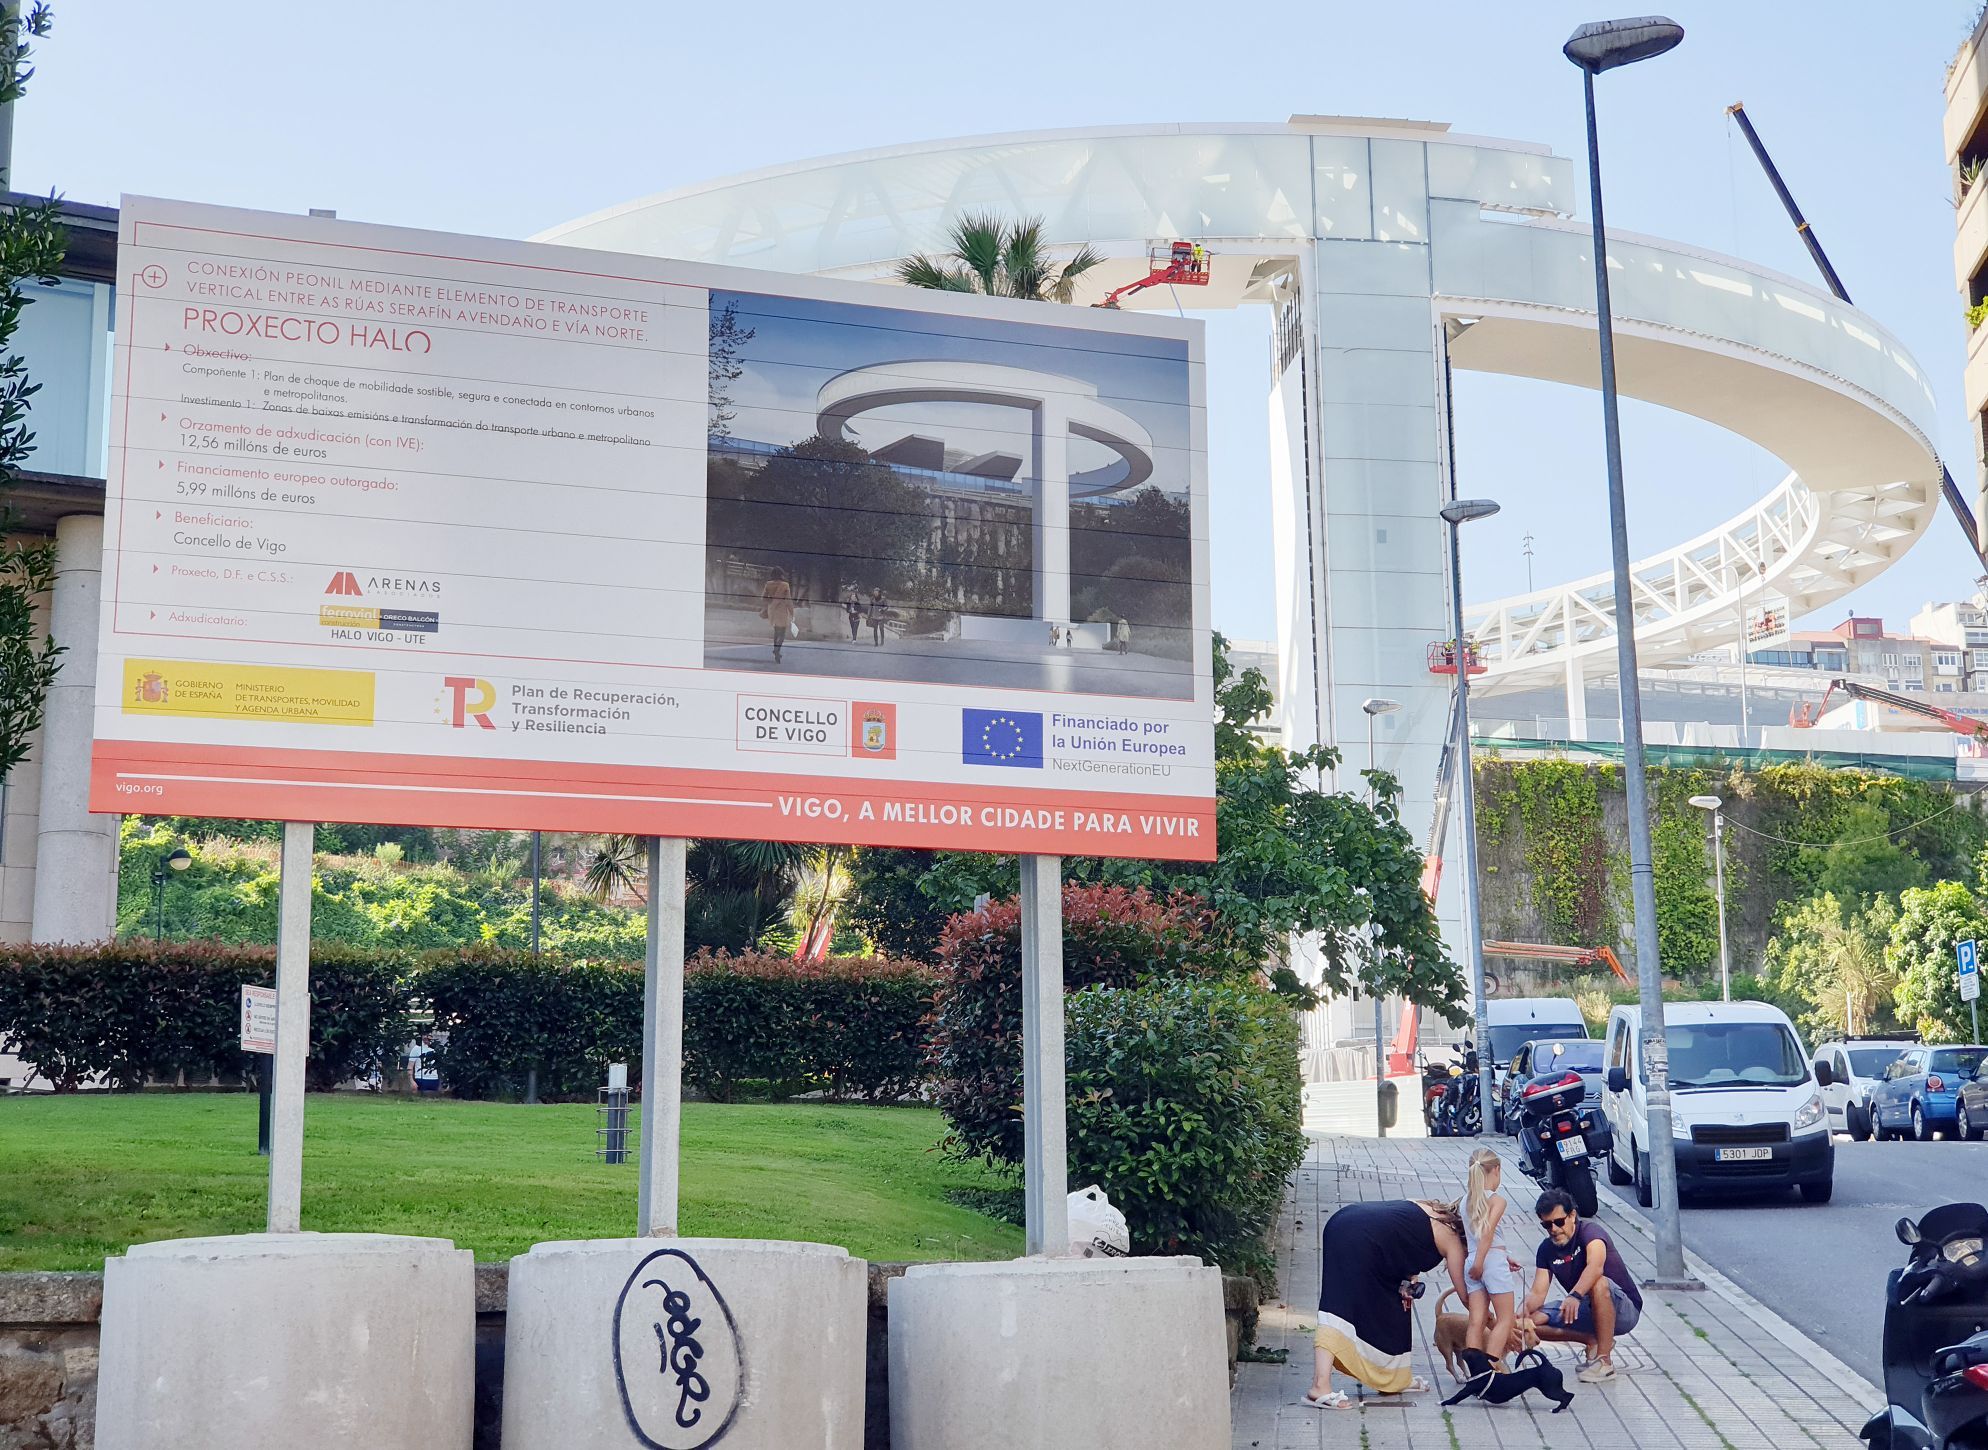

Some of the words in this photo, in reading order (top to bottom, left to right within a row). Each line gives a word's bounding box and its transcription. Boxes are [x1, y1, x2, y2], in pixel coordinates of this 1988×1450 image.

[187, 261, 280, 282] CONEXIÓN
[286, 272, 344, 290] PEONIL
[350, 279, 432, 299] MEDIANTE
[437, 288, 520, 308] ELEMENTO
[525, 298, 545, 311] DE
[550, 300, 648, 323] TRANSPORTE
[187, 281, 263, 301] VERTICAL
[268, 290, 315, 306] ENTRE
[320, 296, 339, 309] AS
[345, 296, 384, 314] RÚAS
[389, 303, 451, 320] SERAFÍN
[457, 310, 547, 330] AVENDAÑO
[552, 320, 560, 332] E
[565, 319, 590, 335] VÍA
[595, 325, 648, 342] NORTE.
[184, 307, 340, 345] PROXECTO
[350, 324, 431, 353] HALO
[183, 344, 252, 362] Obxectivo:
[182, 362, 247, 380] Compoñente
[264, 370, 285, 383] Plan
[288, 373, 301, 384] de
[303, 374, 340, 389] choque
[343, 378, 356, 389] de
[359, 380, 414, 395] mobilidade
[416, 386, 454, 400] sostible,
[458, 391, 491, 403] segura
[493, 394, 500, 403] e
[502, 394, 552, 408] conectada
[555, 400, 567, 409] en
[569, 402, 615, 415] contornos
[617, 406, 655, 418] urbanos
[263, 388, 270, 396] e
[273, 387, 348, 405] metropolitanos.
[180, 393, 242, 409] Investimento
[263, 401, 293, 413] Zonas
[296, 404, 309, 414] de
[312, 406, 344, 418] baixas
[347, 408, 389, 422] emisións
[392, 415, 399, 423] e
[401, 414, 473, 430] transformación
[475, 420, 489, 431] do
[491, 422, 539, 438] transporte
[542, 427, 576, 440] urbano
[578, 432, 584, 440] e
[587, 431, 651, 447] metropolitano
[179, 417, 251, 435] Orzamento
[256, 423, 272, 437] de
[276, 427, 360, 445] adxudicación
[365, 433, 391, 449] (con
[396, 436, 424, 452] IVE):
[180, 433, 219, 450] 12,56
[224, 438, 268, 454] millóns
[273, 443, 289, 456] de
[293, 447, 327, 459] euros
[177, 460, 270, 480] Financiamento
[273, 472, 326, 486] europeo
[330, 475, 399, 492] outorgado:
[176, 481, 207, 497] 5,99
[211, 485, 256, 501] millóns
[261, 488, 277, 501] de
[281, 493, 316, 505] euros
[175, 511, 253, 528] Beneficiario:
[173, 531, 231, 548] Concello
[235, 536, 252, 549] de
[257, 537, 287, 555] Vigo
[171, 565, 219, 579] Proxecto,
[367, 577, 441, 593] ARENAS
[168, 611, 248, 626] Adxudicatario:
[331, 629, 362, 640] HALO
[367, 631, 394, 643] VIGO
[404, 634, 426, 645] UTE
[174, 690, 187, 698] DE
[190, 689, 223, 700] ESPAÑA
[175, 680, 223, 690] GOBIERNO
[235, 683, 285, 693] MINISTERIO
[235, 694, 247, 702] DE
[248, 694, 311, 706] TRANSPORTES,
[311, 698, 361, 708] MOVILIDAD
[511, 684, 544, 699] Plan
[549, 687, 568, 700] de
[573, 688, 680, 708] Recuperación,
[235, 704, 240, 712] Y
[241, 704, 279, 714] AGENDA
[281, 706, 319, 716] URBANA
[511, 702, 631, 721] Transformación
[745, 707, 838, 726] CONCELLO
[511, 720, 520, 733] y
[525, 719, 607, 735] Resiliencia
[756, 725, 778, 740] DE
[785, 727, 827, 743] VIGO
[1052, 713, 1139, 732] Financiado
[1143, 722, 1170, 736] por
[1052, 734, 1065, 748] la
[1071, 735, 1117, 751] Unión
[1122, 738, 1186, 757] Europea
[1052, 757, 1171, 777] NextGenerationEU
[115, 781, 163, 796] vigo.org
[778, 796, 849, 823] VIGO,
[858, 800, 875, 821] A
[883, 802, 973, 826] MELLOR
[980, 807, 1065, 830] CIDADE
[1073, 811, 1133, 834] PARA
[1139, 815, 1199, 837] VIVIR
[1723, 1149, 1746, 1159] 5301
[1752, 1148, 1769, 1159] JDP
